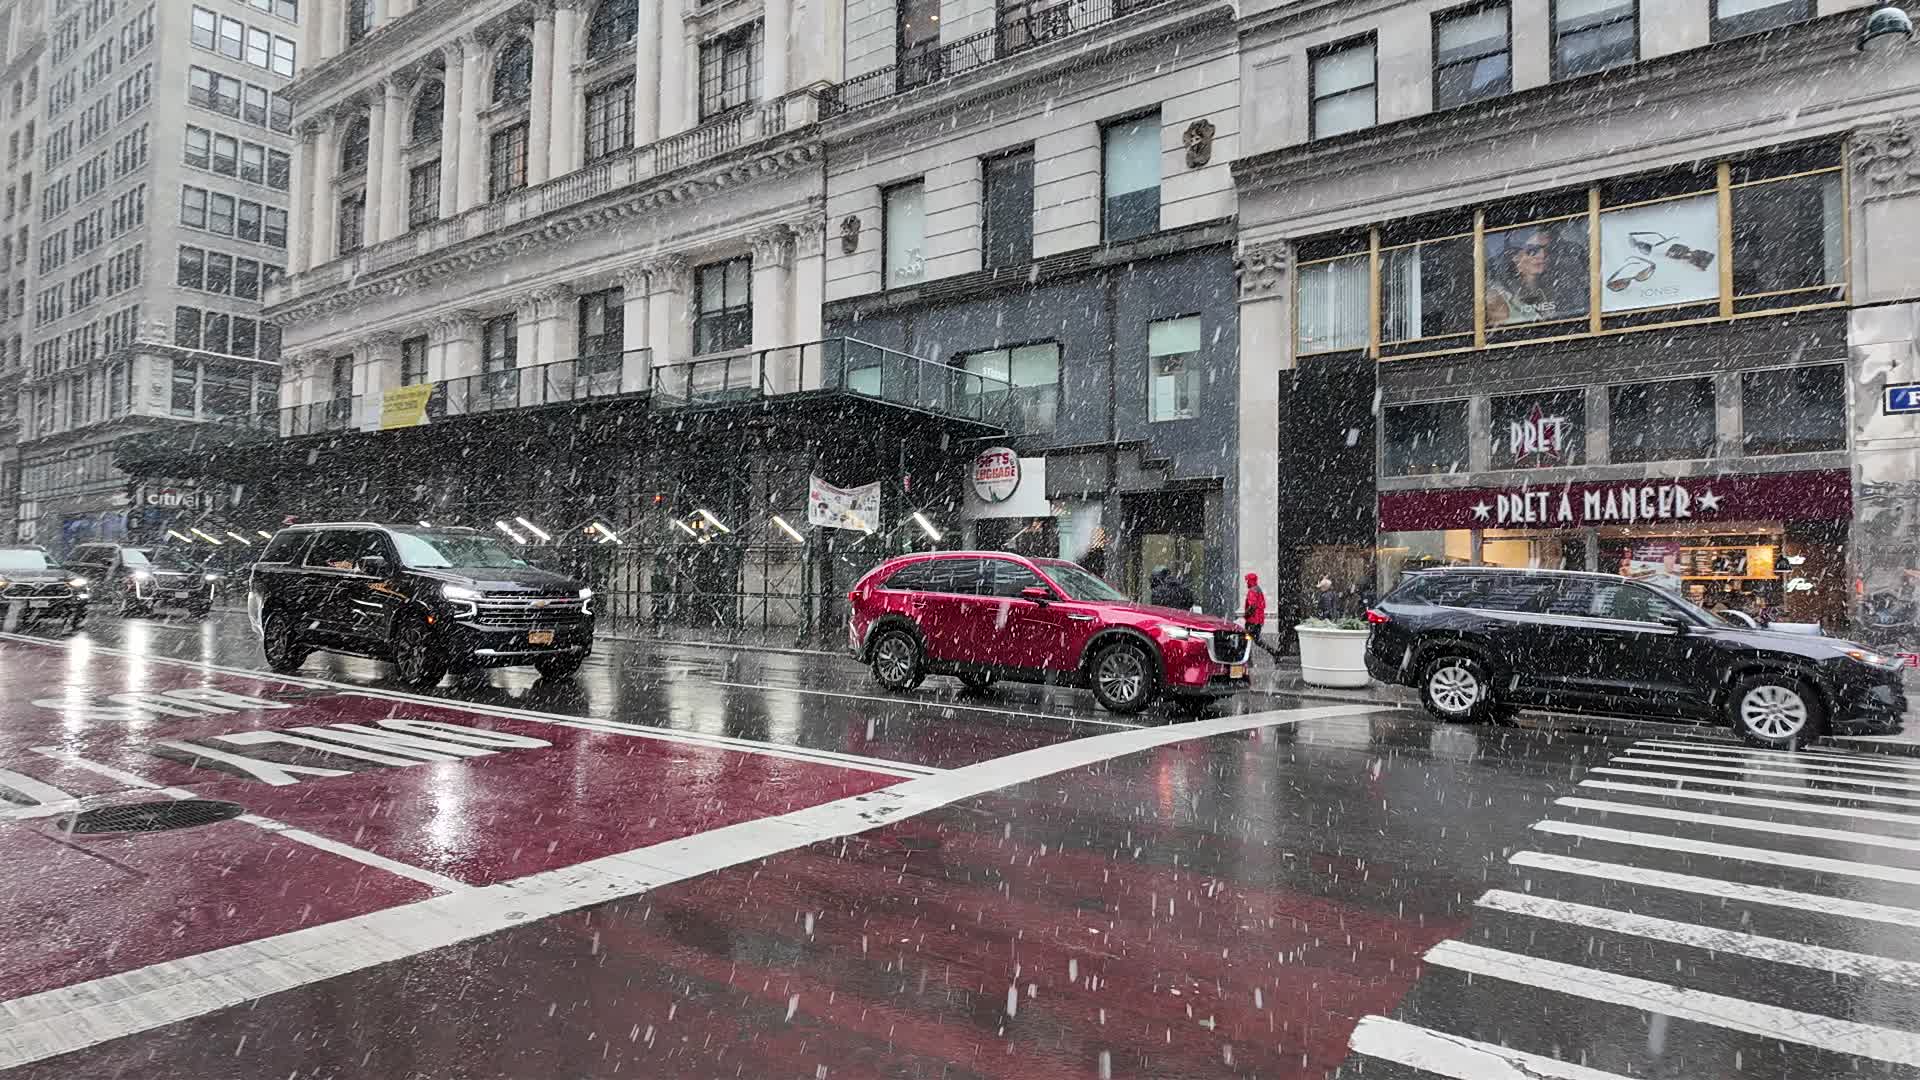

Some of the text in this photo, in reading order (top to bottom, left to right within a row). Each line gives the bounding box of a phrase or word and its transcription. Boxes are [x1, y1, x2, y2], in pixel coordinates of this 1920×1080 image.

[1511, 417, 1564, 454] PRET
[1497, 485, 1692, 524] PRET A MANGER
[156, 718, 553, 786] ONLY
